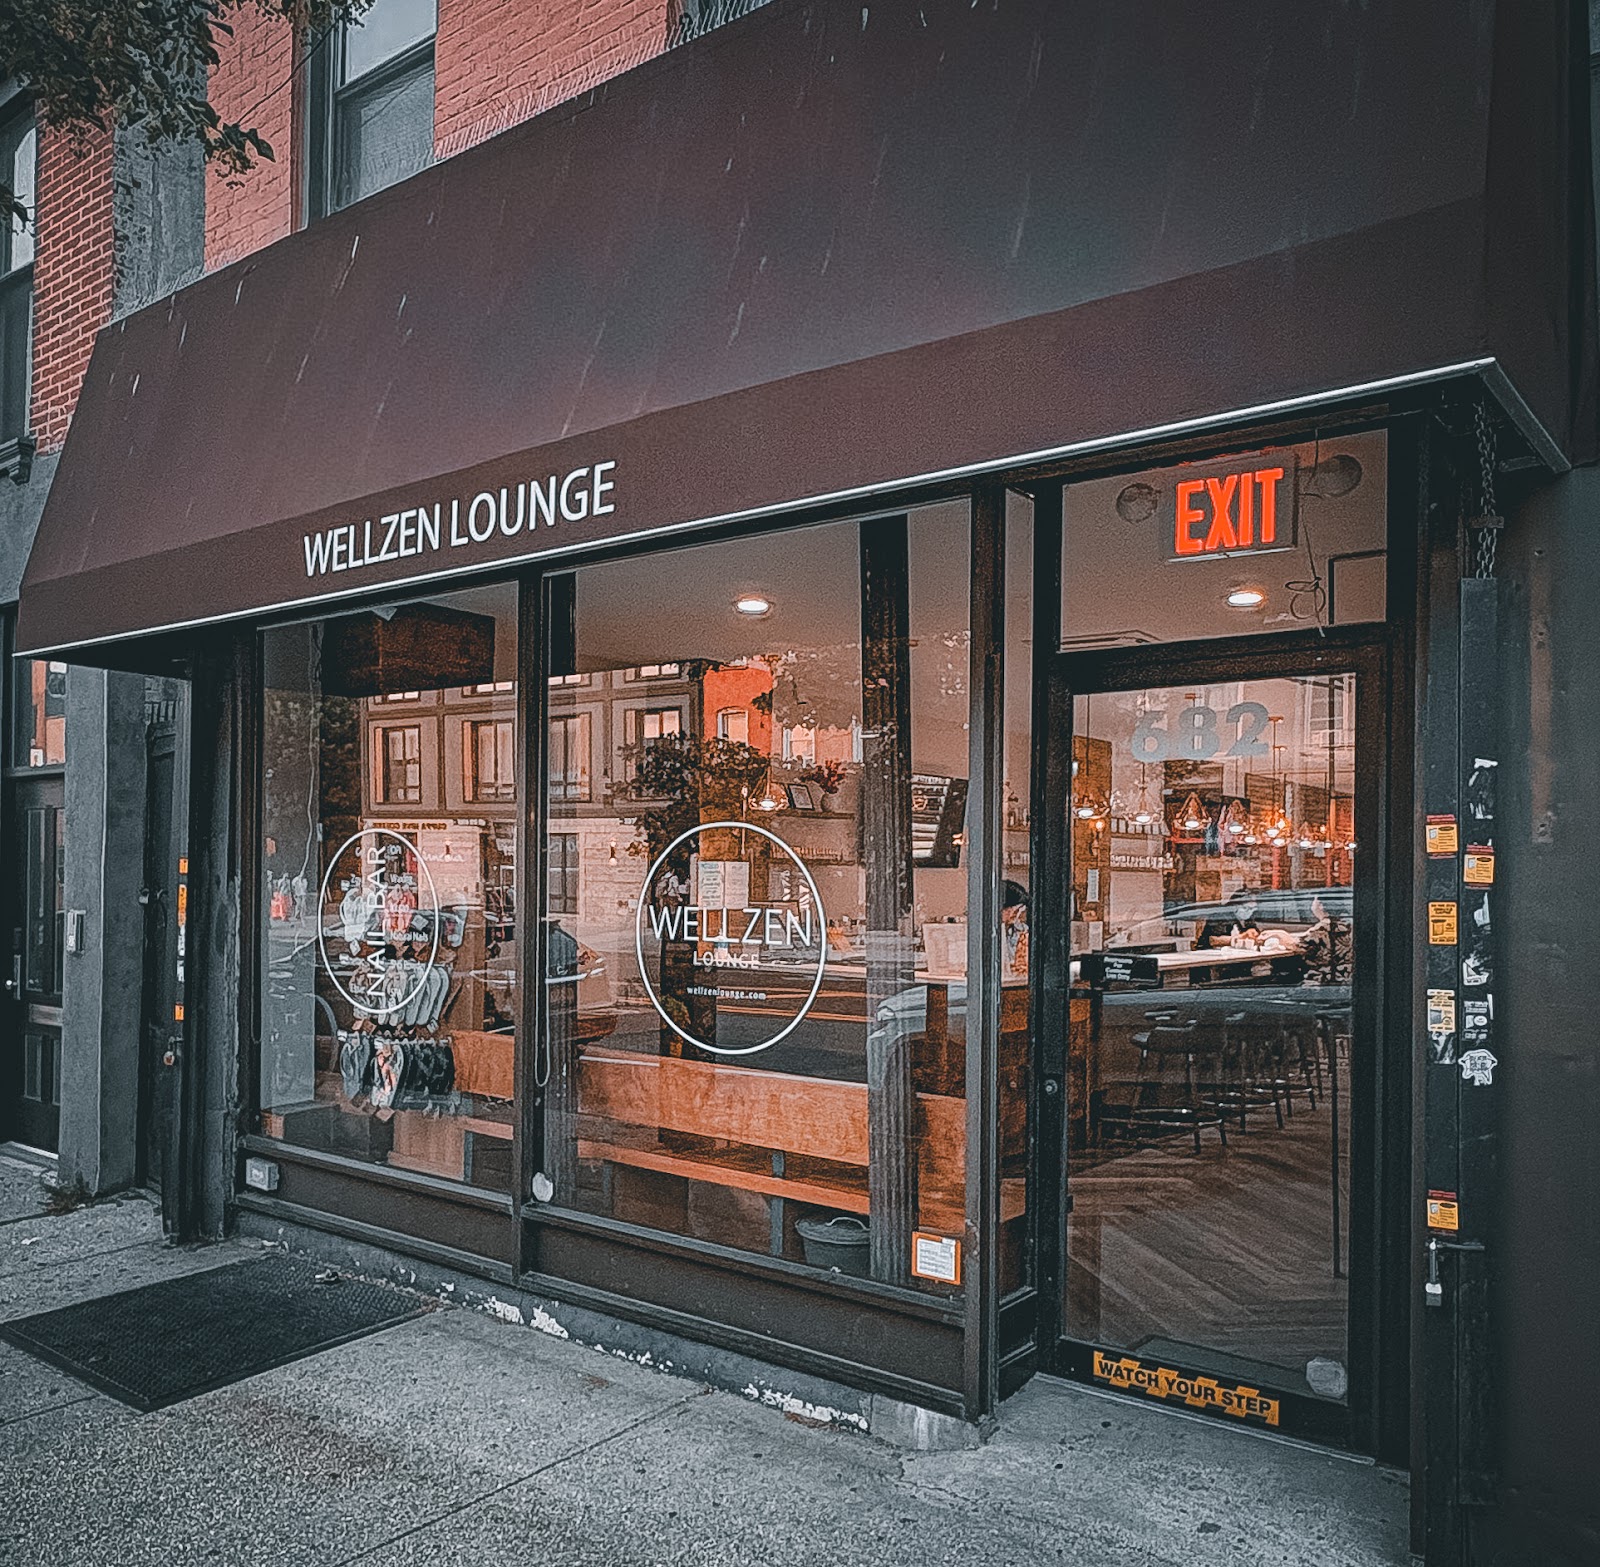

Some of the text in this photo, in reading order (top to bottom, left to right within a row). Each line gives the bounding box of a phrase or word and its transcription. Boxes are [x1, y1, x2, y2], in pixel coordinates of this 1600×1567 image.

[303, 459, 617, 578] WELLZEN LOUNGE
[1174, 466, 1285, 555] EXIT
[1131, 701, 1270, 763] 682
[366, 844, 386, 997] NAIL BAR
[649, 904, 812, 948] WELLZEN
[692, 950, 760, 970] LOUNGE
[686, 986, 767, 1001] wellzenlounge.com
[1098, 1359, 1272, 1414] WATCH YOUR STEP
